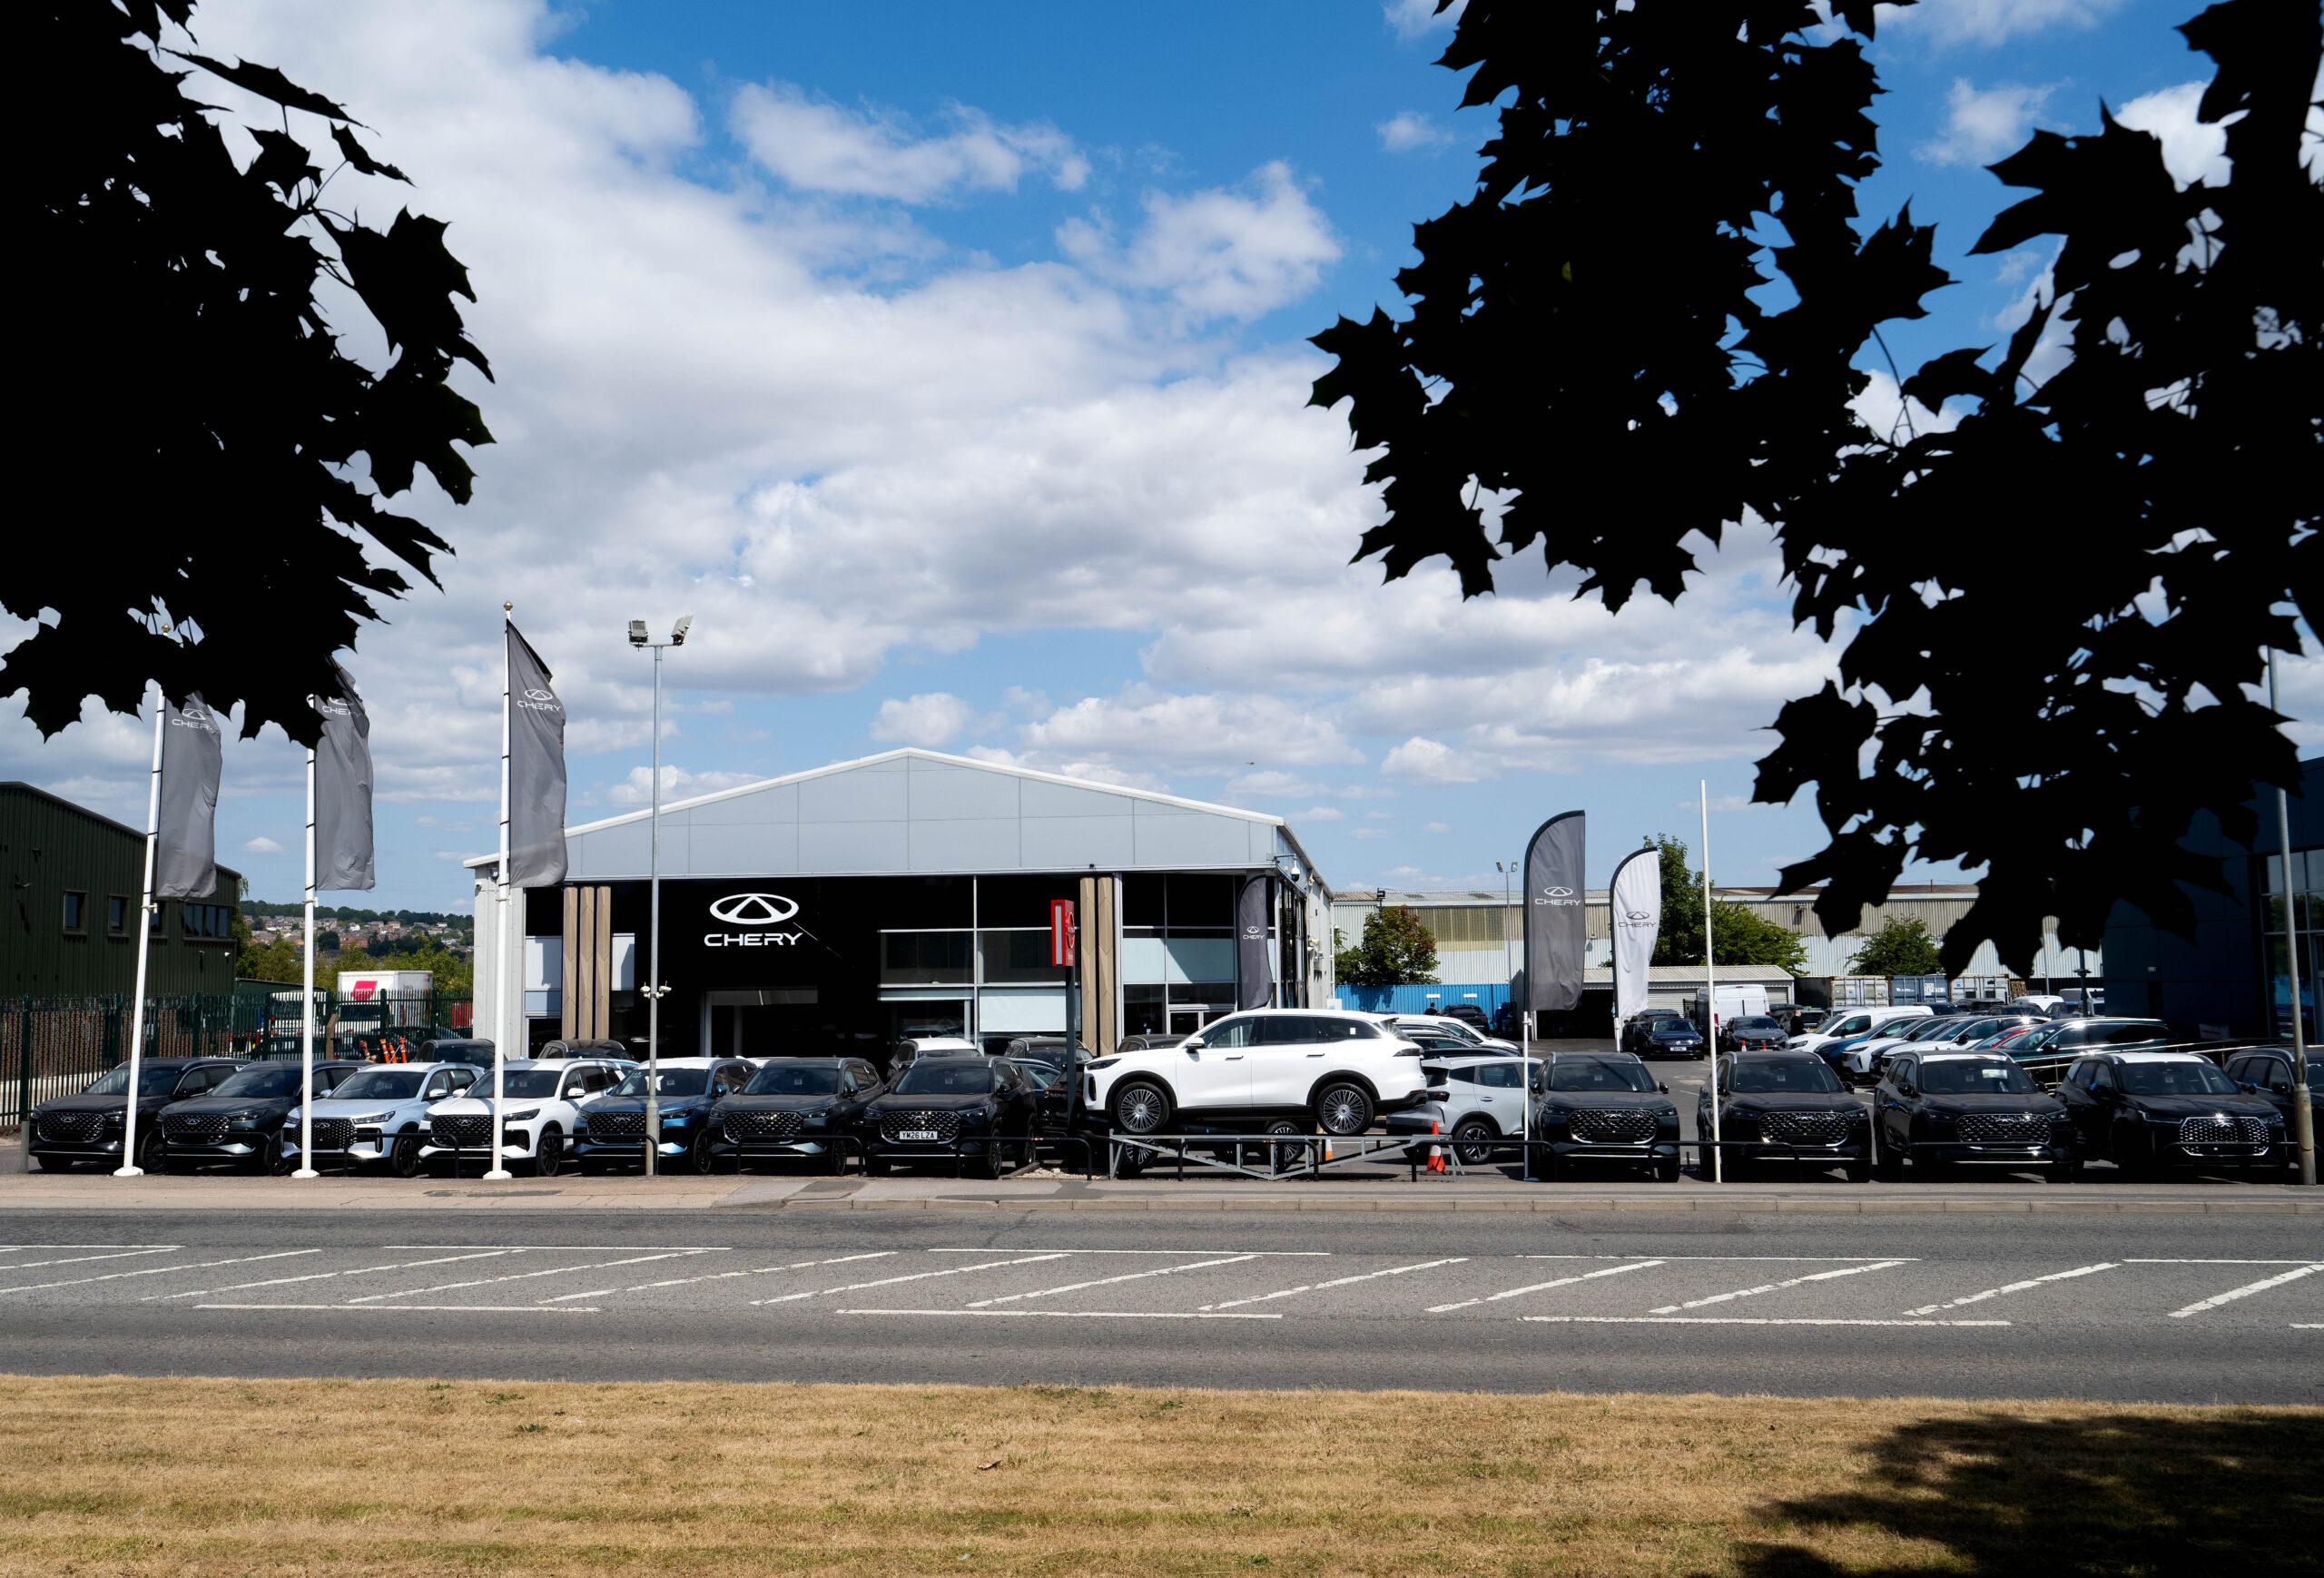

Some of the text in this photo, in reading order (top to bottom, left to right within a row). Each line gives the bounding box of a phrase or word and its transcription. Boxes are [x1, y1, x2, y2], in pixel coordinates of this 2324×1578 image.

[517, 700, 561, 712] CHERY
[1534, 898, 1581, 906] CHERY
[704, 932, 803, 947] CHERY
